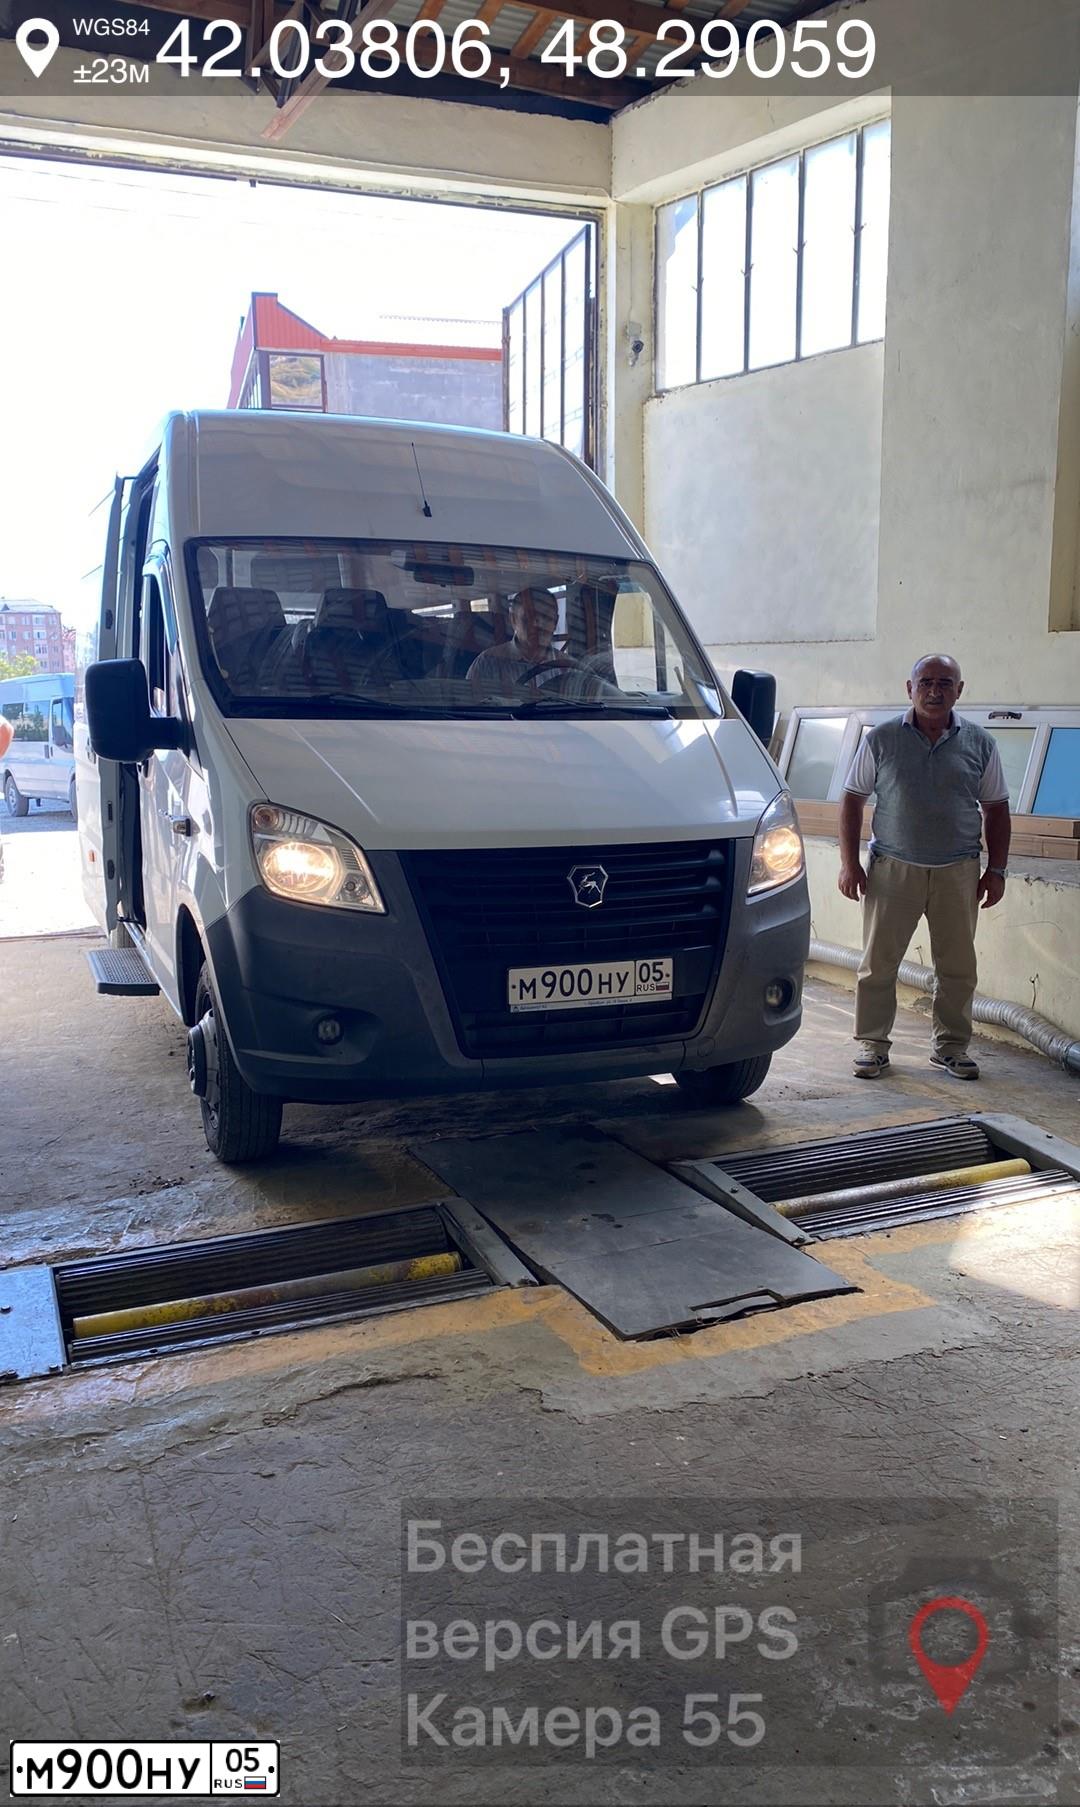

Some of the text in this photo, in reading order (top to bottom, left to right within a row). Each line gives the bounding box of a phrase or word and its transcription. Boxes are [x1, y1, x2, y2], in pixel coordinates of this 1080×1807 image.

[638, 961, 664, 983] 05
[519, 968, 629, 1000] М900НУ
[636, 983, 656, 993] RUS
